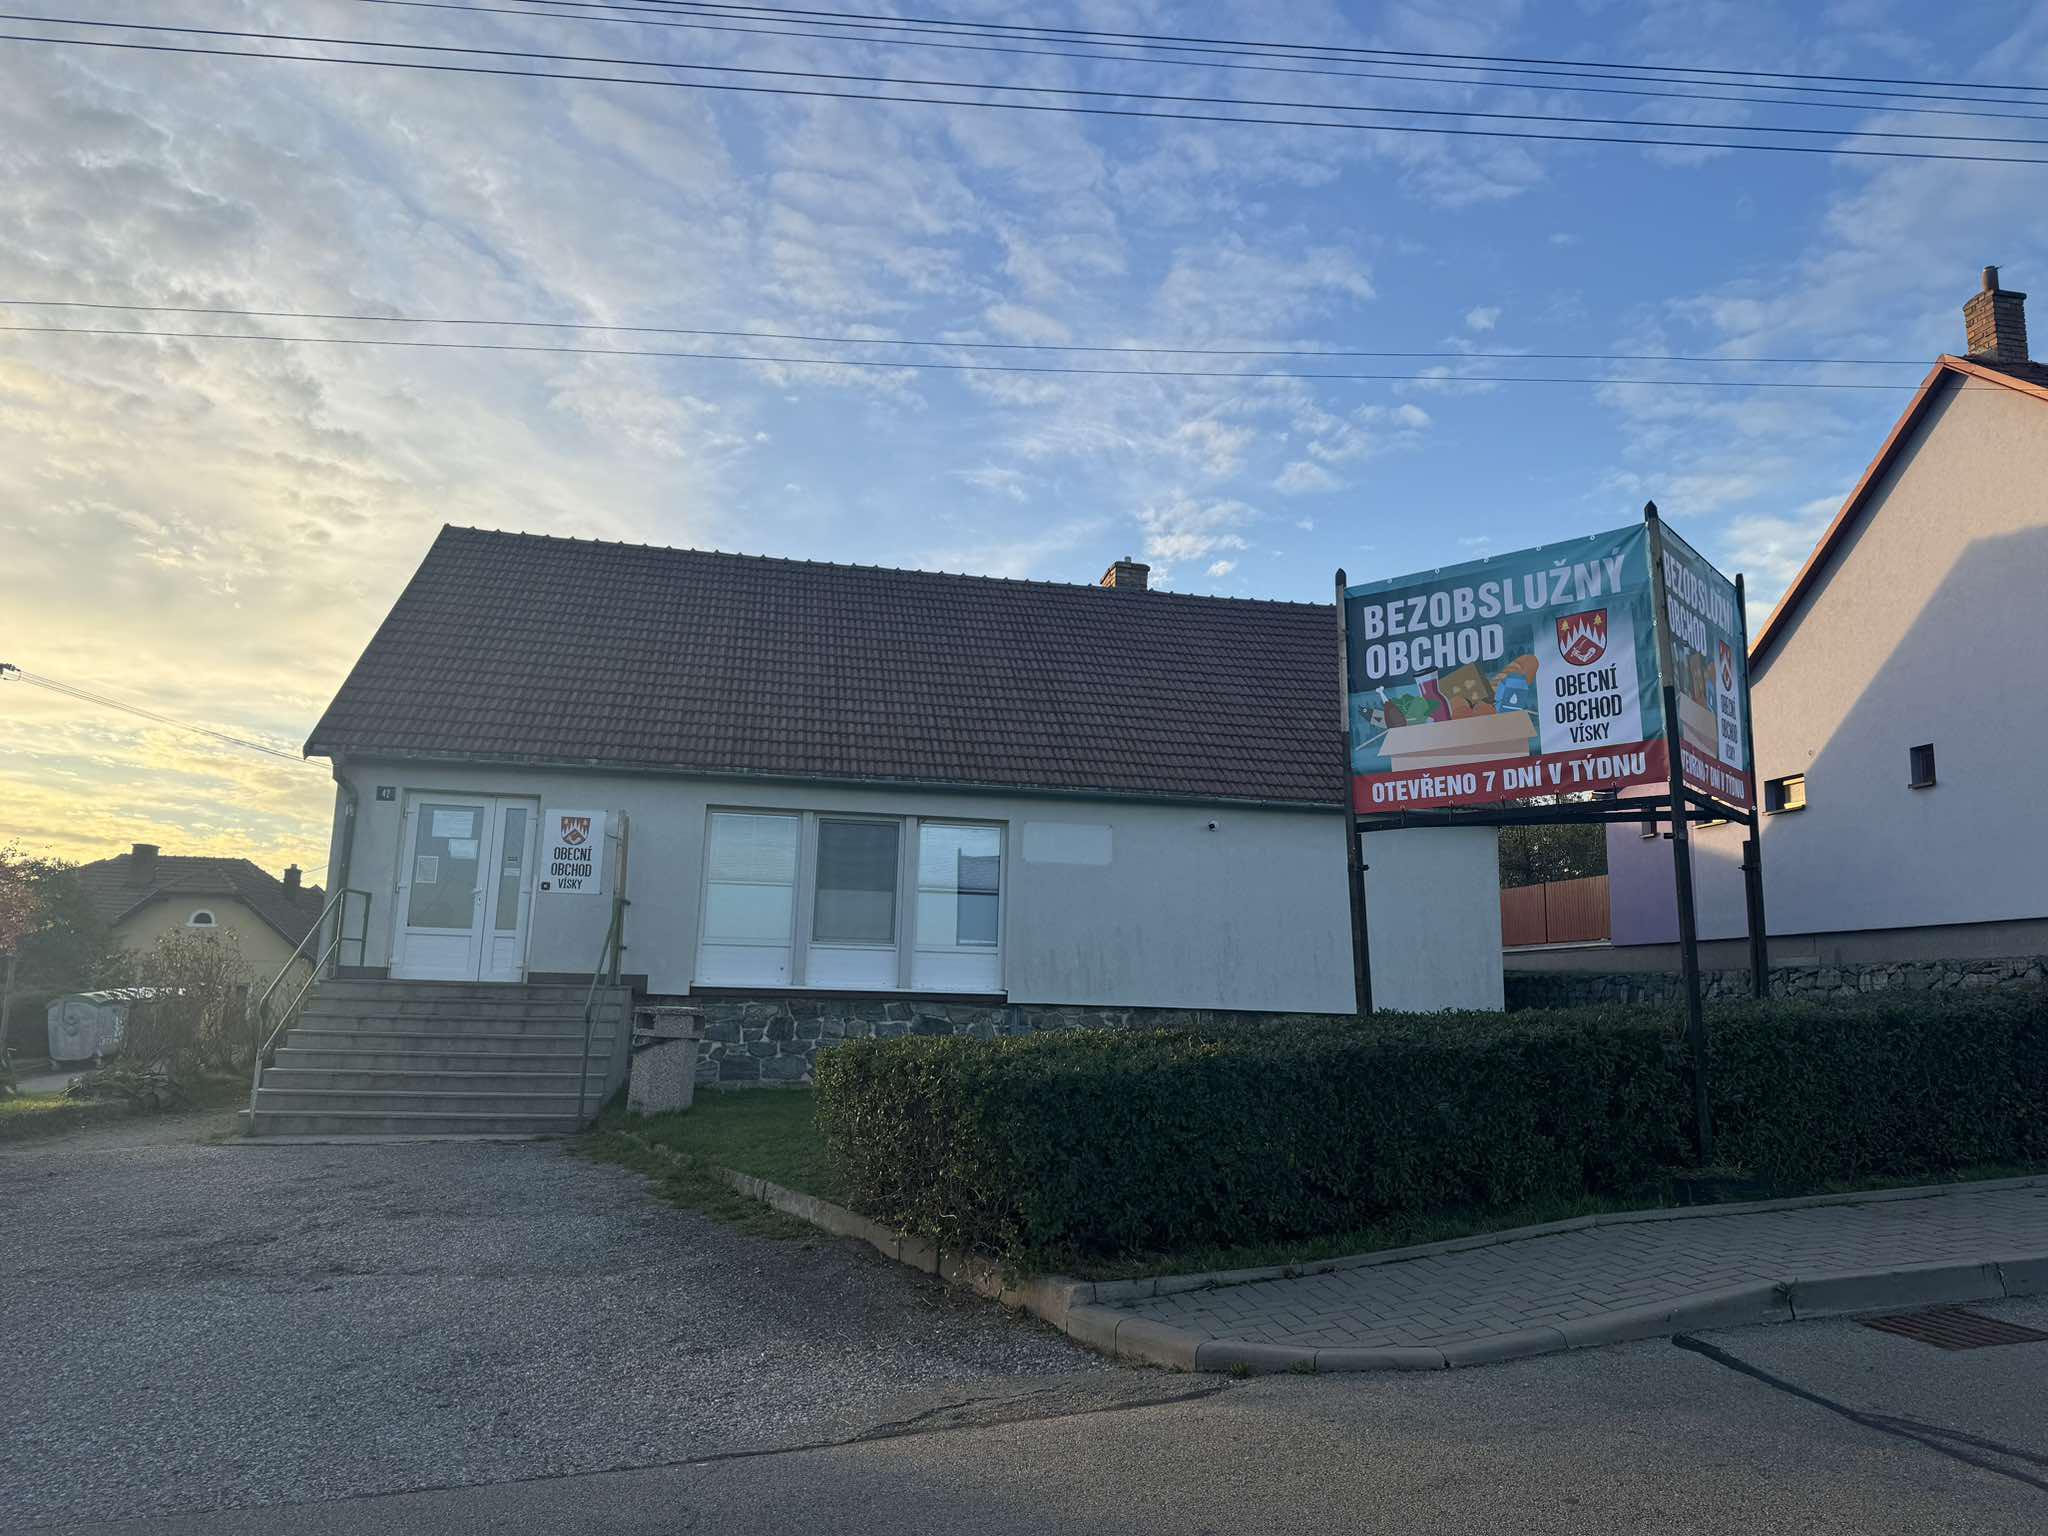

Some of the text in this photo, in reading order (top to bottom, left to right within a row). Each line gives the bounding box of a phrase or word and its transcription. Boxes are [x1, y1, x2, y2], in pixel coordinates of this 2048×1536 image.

[1364, 547, 1625, 640] BEZOBSLUŽNÝ
[1667, 594, 1707, 657] OBCHOD
[1366, 623, 1504, 680] OBCHOD
[1555, 667, 1618, 697] OBECNÍ
[1555, 694, 1622, 724] OBCHOD
[1569, 722, 1610, 744] VÍSKY
[1372, 752, 1647, 803] OTEVŘENO 7 DNÍ V TÝDNU
[554, 846, 592, 861] OBECNÍ
[551, 862, 592, 877] OBCHOD
[558, 878, 583, 889] VÍSKY
